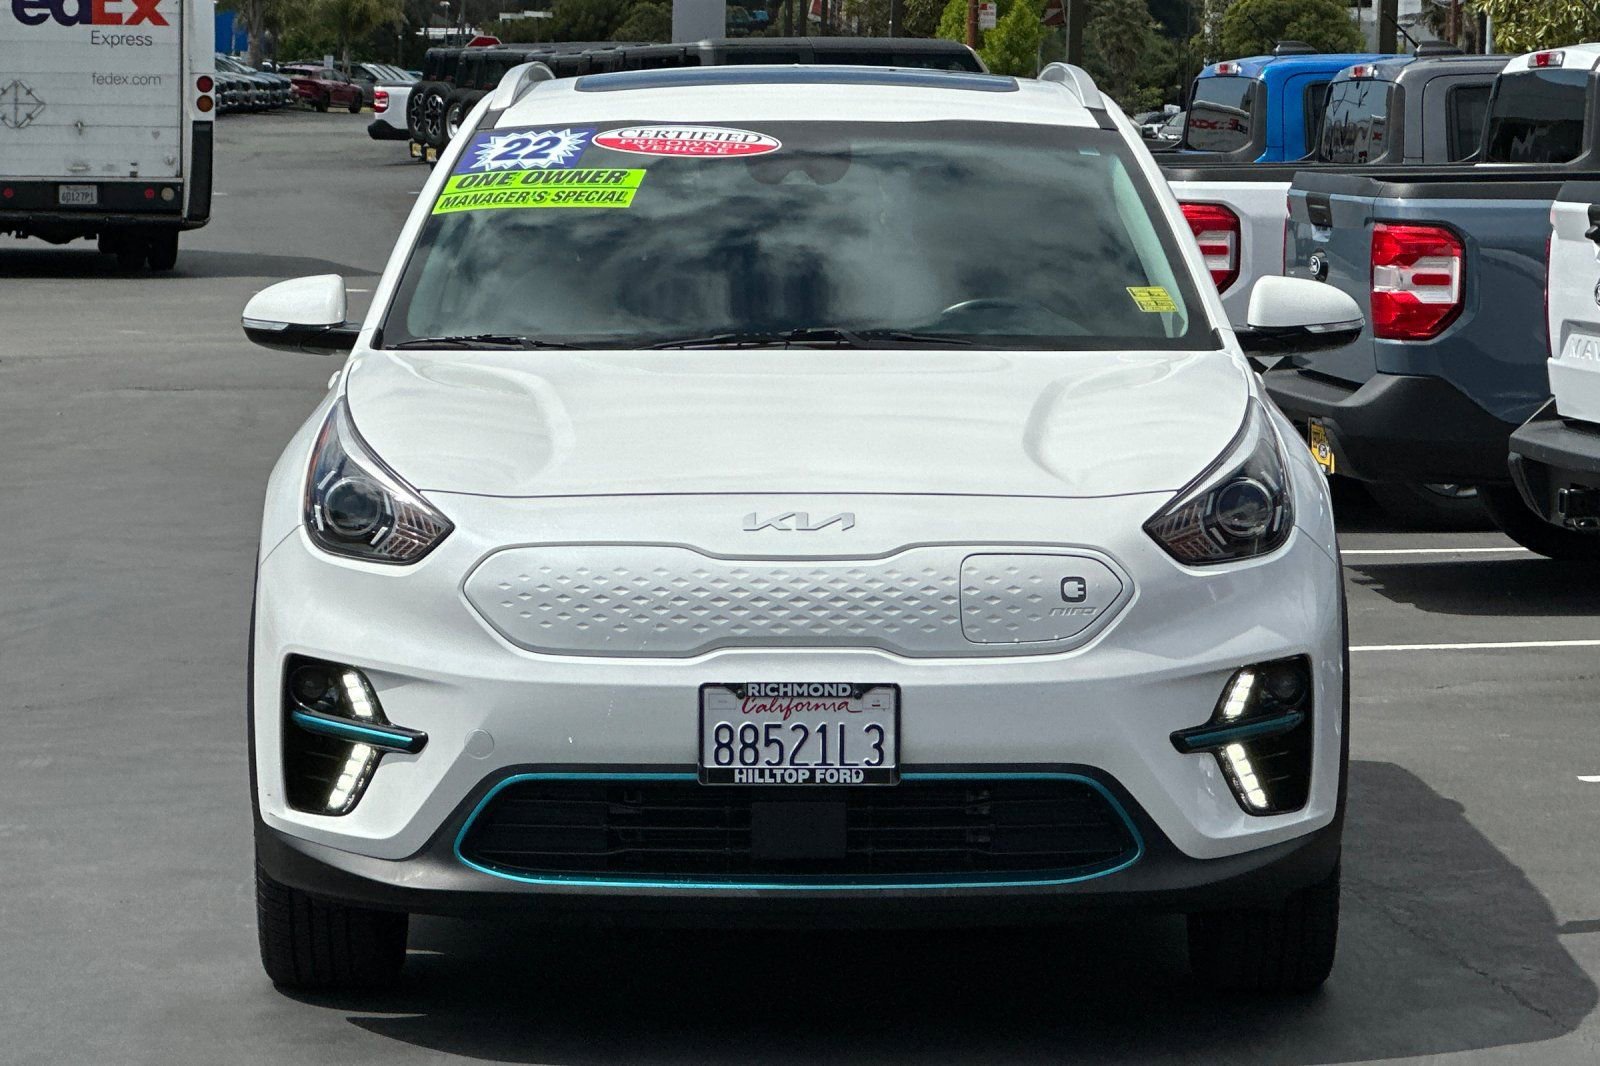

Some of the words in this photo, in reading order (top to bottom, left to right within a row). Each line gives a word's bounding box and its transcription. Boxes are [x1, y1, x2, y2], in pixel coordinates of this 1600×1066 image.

[90, 30, 153, 48] Express
[92, 72, 162, 86] fedex.com
[617, 129, 762, 143] CERTIFIED
[619, 138, 750, 150] PRE-OWNED
[490, 136, 562, 161] 22
[637, 145, 729, 154] VEHICLE
[455, 171, 519, 190] ONE
[520, 170, 630, 186] OWNER
[440, 190, 550, 210] MANAGER'S
[550, 190, 627, 205] SPECIAL
[743, 511, 856, 532] KIA
[747, 683, 852, 697] RICHMOND
[741, 696, 863, 721] California
[714, 722, 885, 767] 88521L3
[734, 769, 810, 784] HILLTOP
[815, 769, 864, 784] FORD
